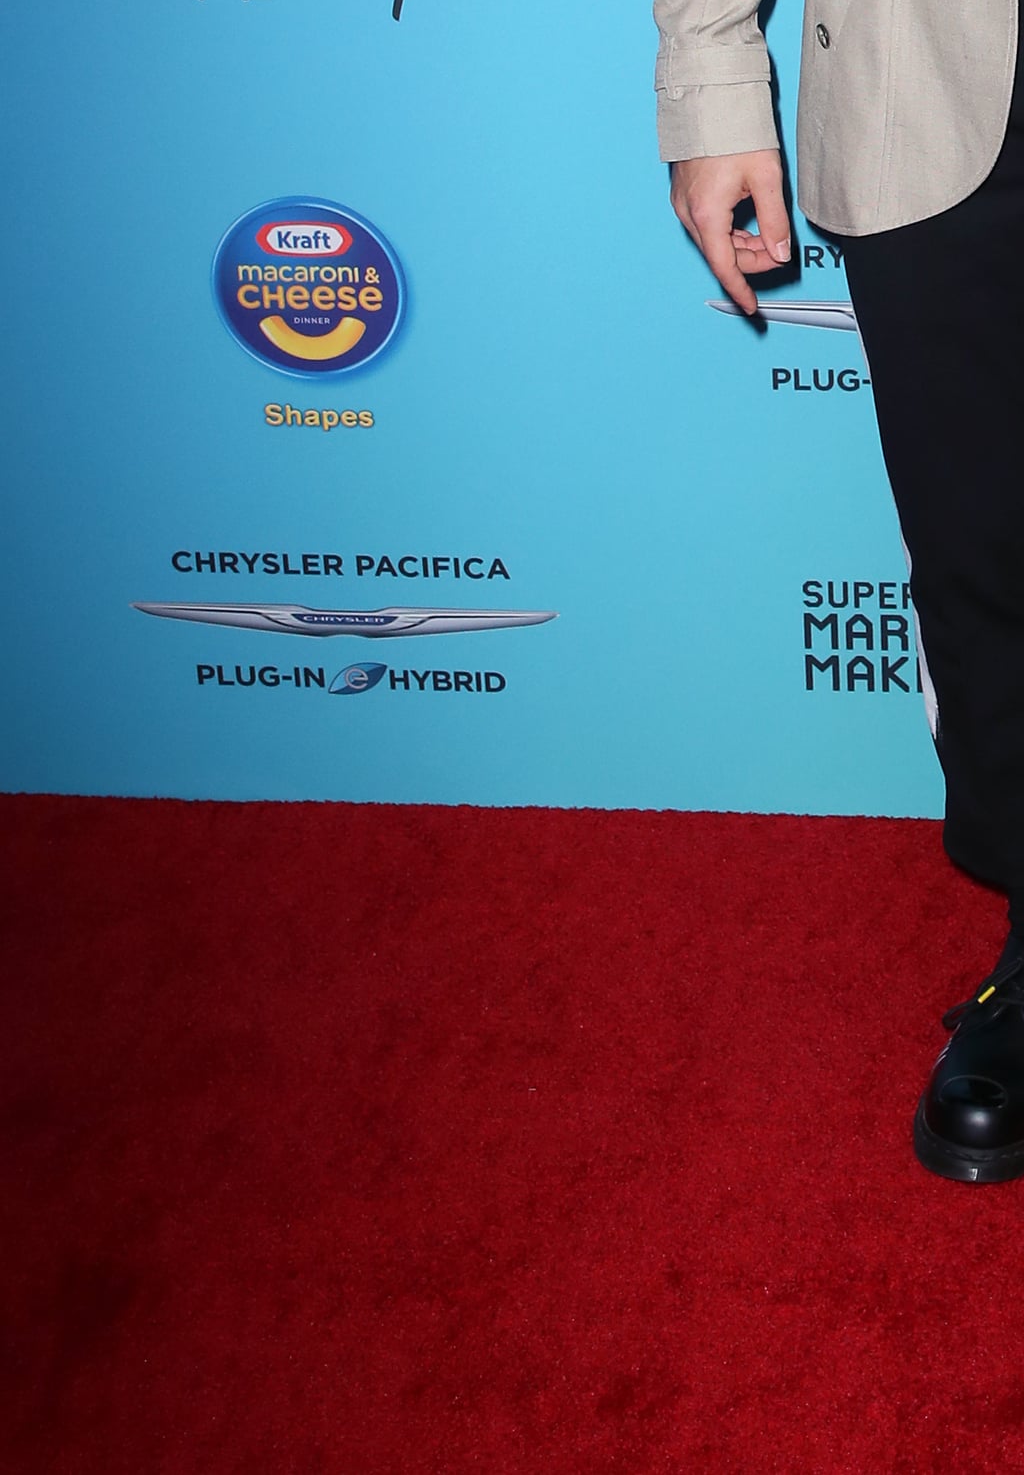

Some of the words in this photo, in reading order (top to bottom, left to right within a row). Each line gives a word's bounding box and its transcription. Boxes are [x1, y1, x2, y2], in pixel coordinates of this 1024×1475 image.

[277, 230, 331, 249] Kraft
[237, 264, 359, 283] macaroni
[364, 267, 381, 284] &
[293, 316, 331, 325] DINNER
[772, 368, 871, 392] PLUG-
[264, 403, 375, 431] Shapes
[171, 551, 344, 577] CHRYSLER
[356, 555, 511, 581] PACIFICA
[303, 615, 386, 624] CHRYSLER
[804, 613, 910, 652] MAR
[196, 664, 326, 688] PLUG-IN
[389, 669, 507, 693] HYBRID
[805, 655, 923, 694] MAK
